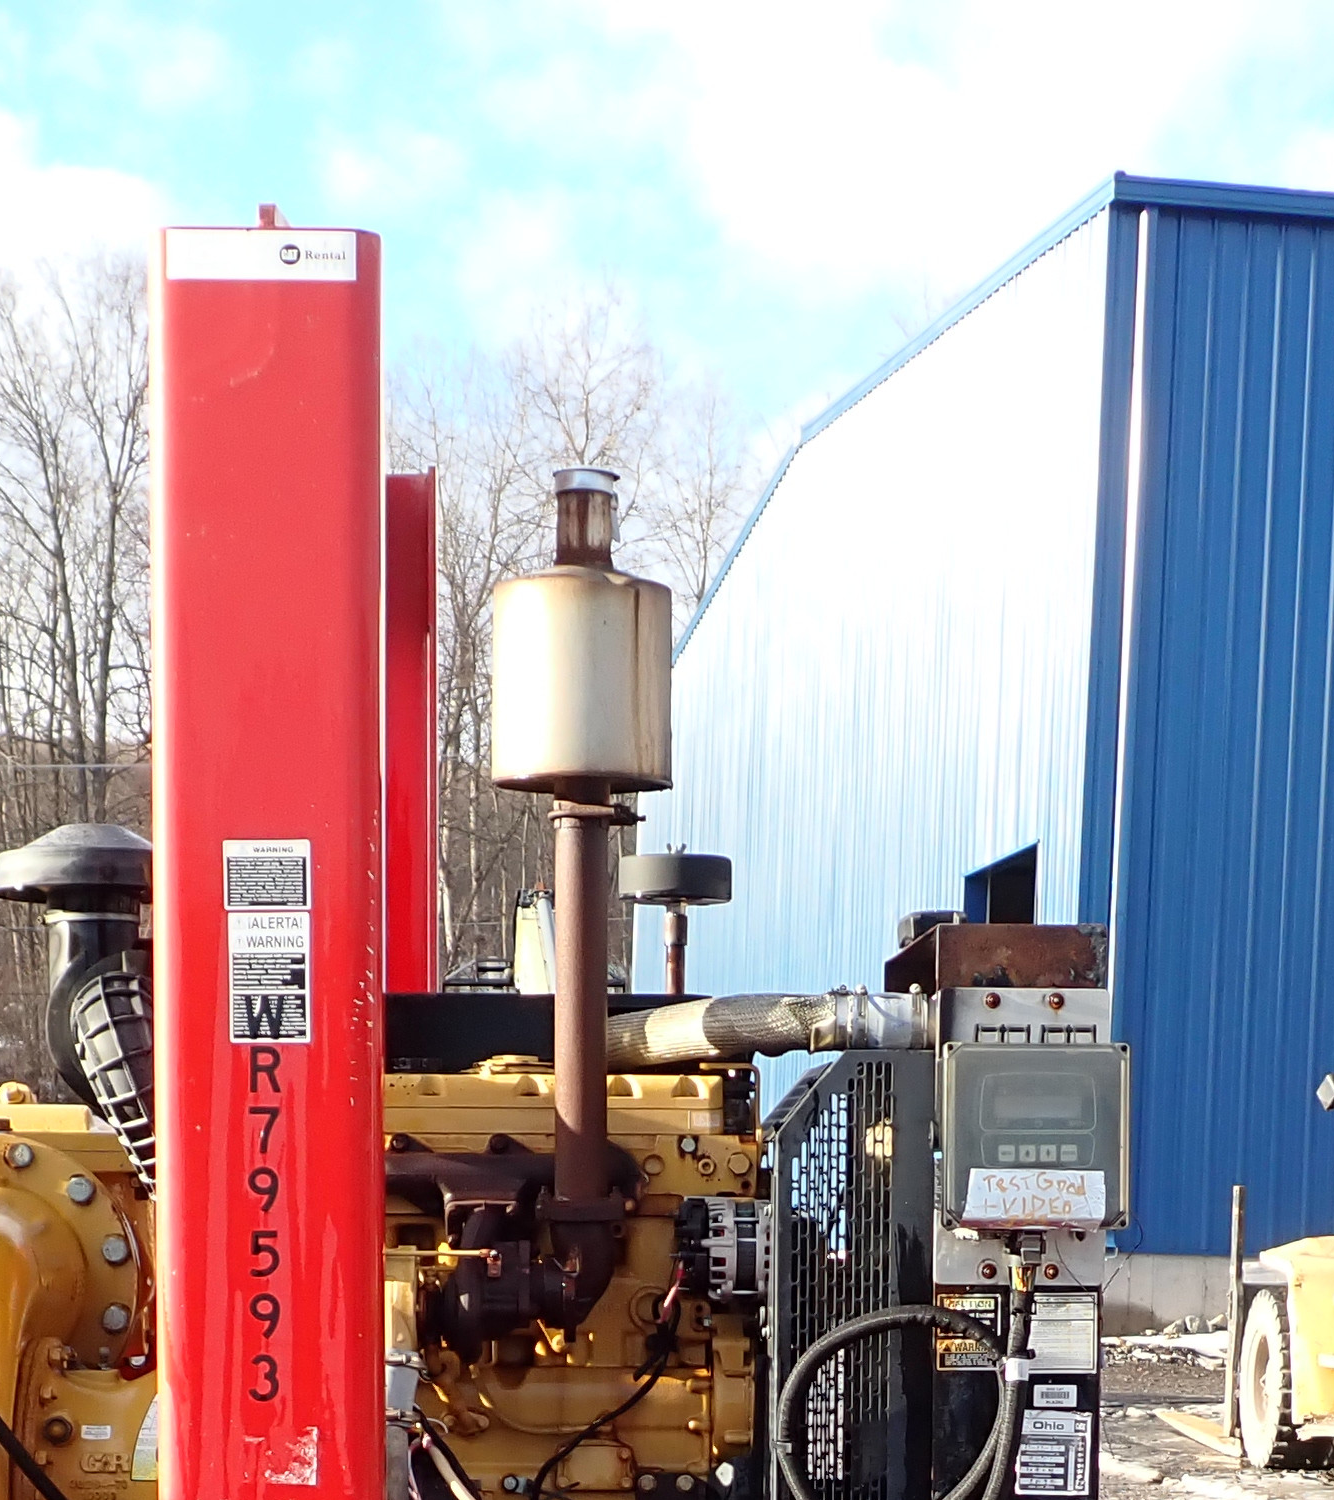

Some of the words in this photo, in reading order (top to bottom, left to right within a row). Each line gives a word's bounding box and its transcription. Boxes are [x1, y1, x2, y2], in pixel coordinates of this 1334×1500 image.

[304, 249, 347, 261] Rental
[246, 934, 305, 948] WARNING
[1032, 1420, 1065, 1431] Ohio
